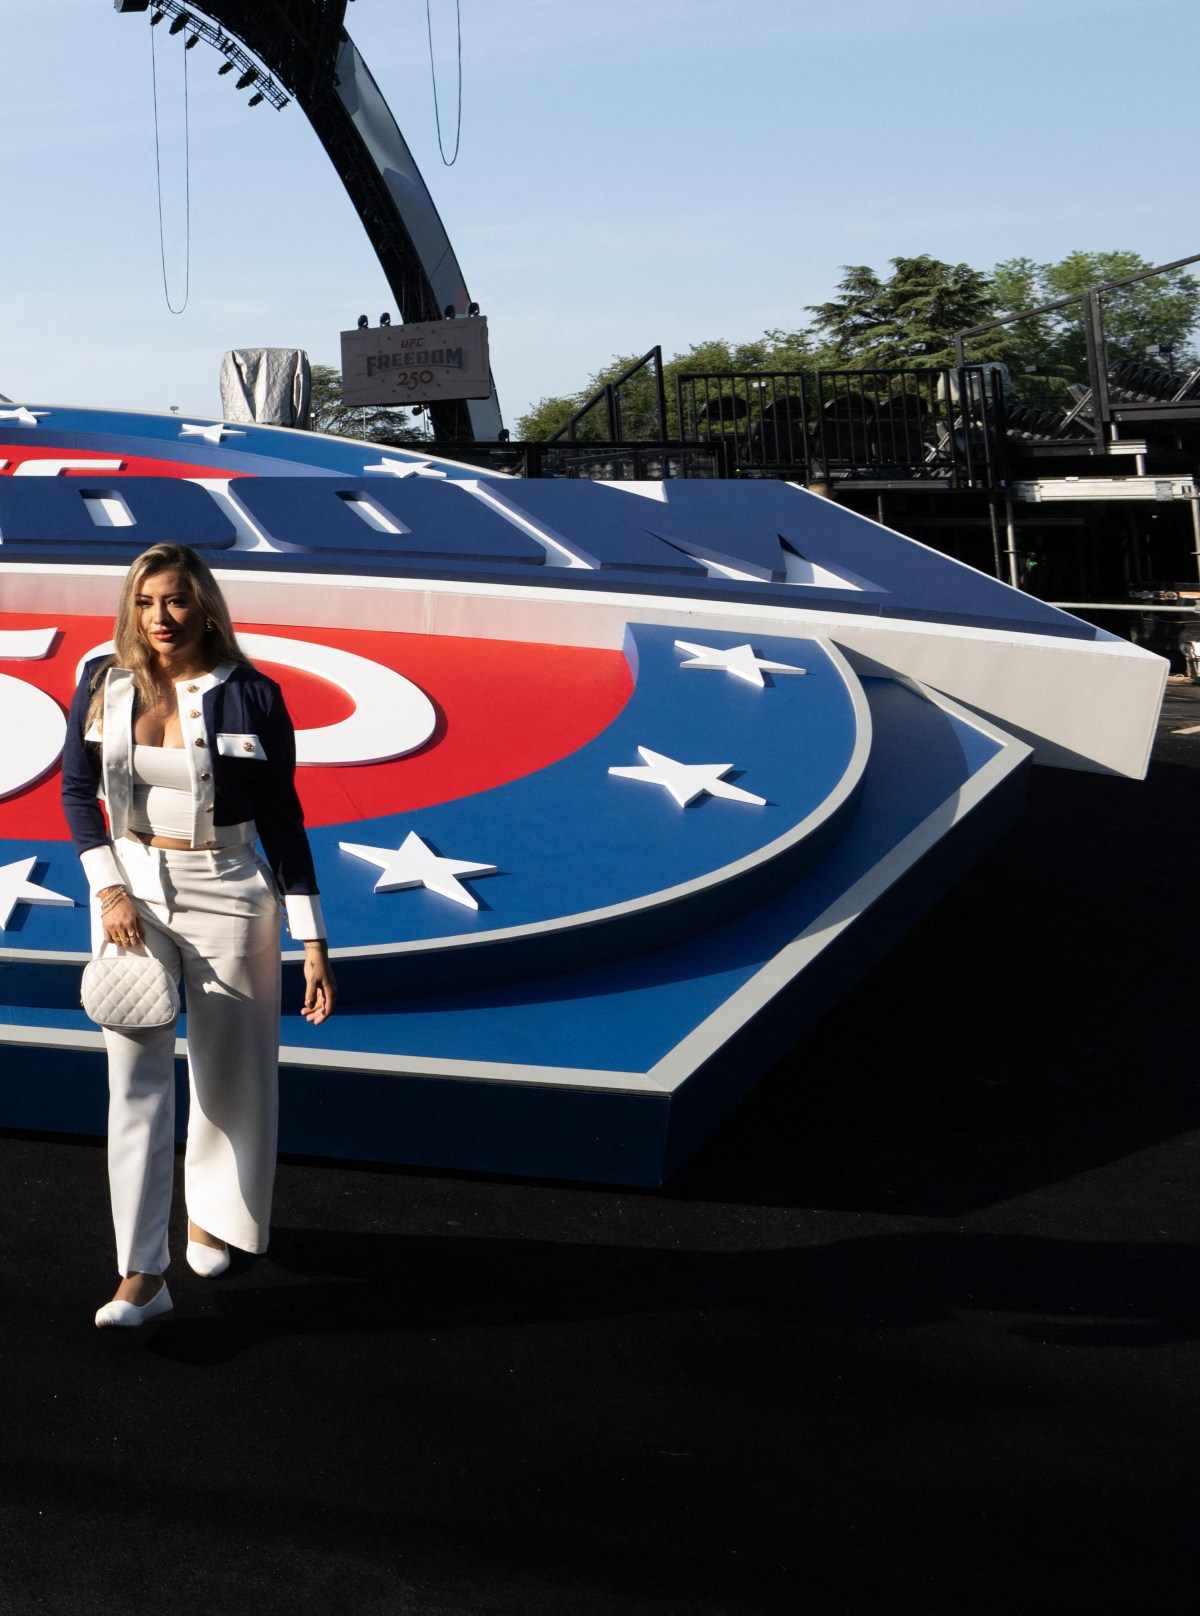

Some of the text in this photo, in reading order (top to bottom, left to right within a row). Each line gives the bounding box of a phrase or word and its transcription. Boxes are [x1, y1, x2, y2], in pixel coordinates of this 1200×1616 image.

[400, 337, 425, 348] UFC
[366, 347, 463, 377] FREEDOM
[397, 370, 434, 390] 250
